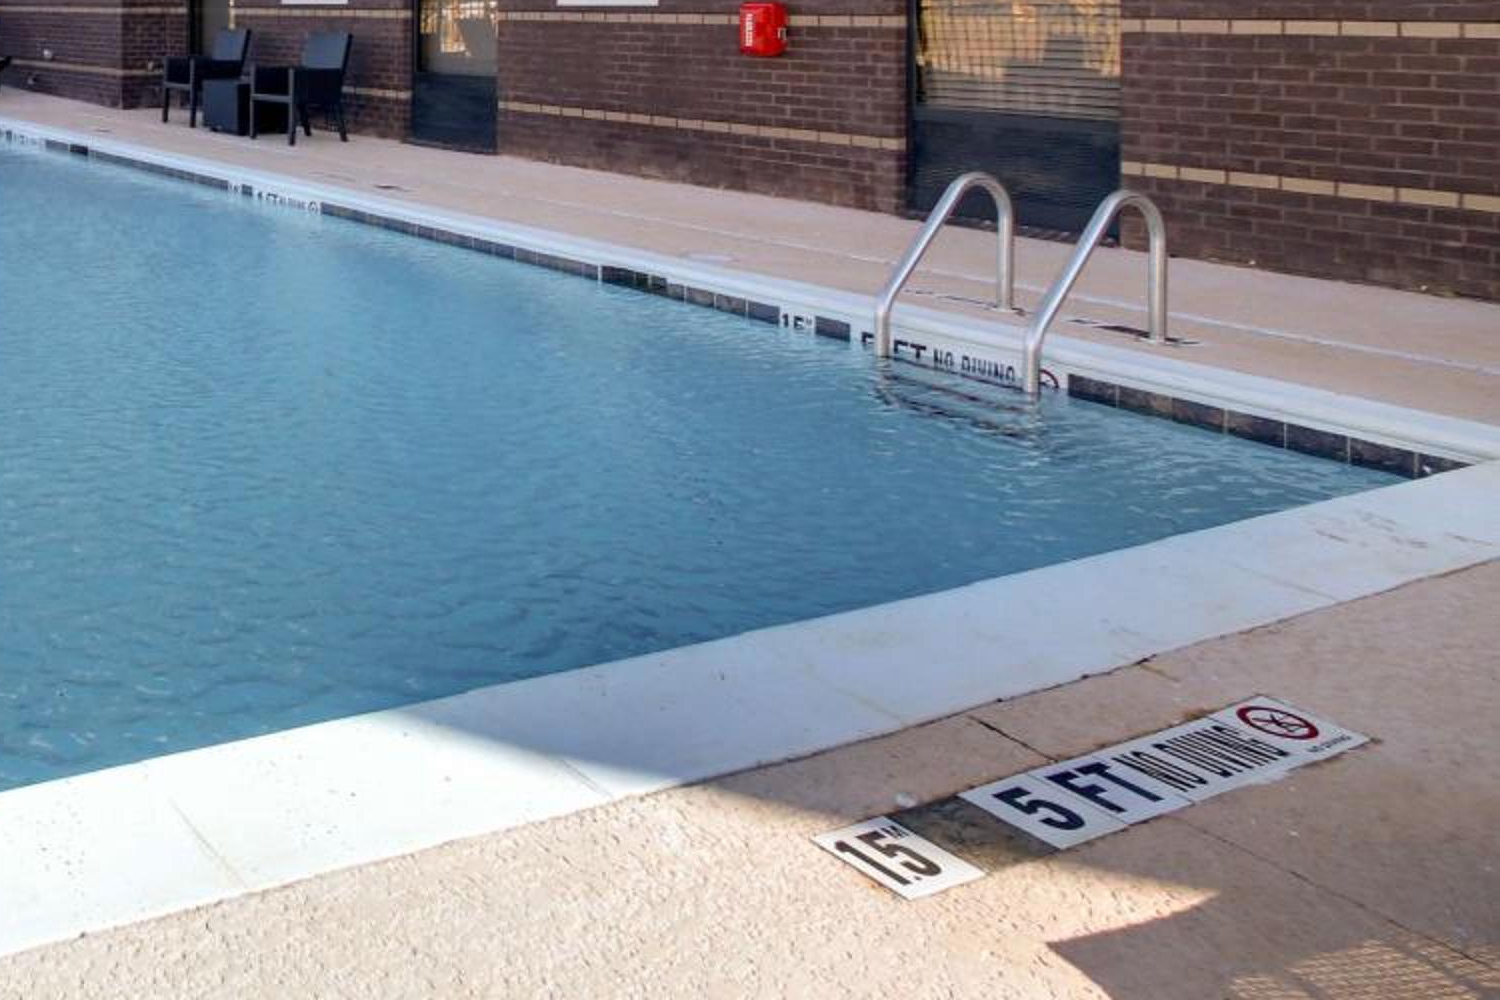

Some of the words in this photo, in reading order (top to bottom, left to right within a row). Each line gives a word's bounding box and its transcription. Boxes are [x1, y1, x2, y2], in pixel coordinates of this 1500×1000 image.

[933, 348, 954, 368] NO
[1111, 751, 1208, 793] NO
[1152, 725, 1290, 778] DIVING
[992, 786, 1086, 832] 5
[1045, 762, 1166, 813] FT
